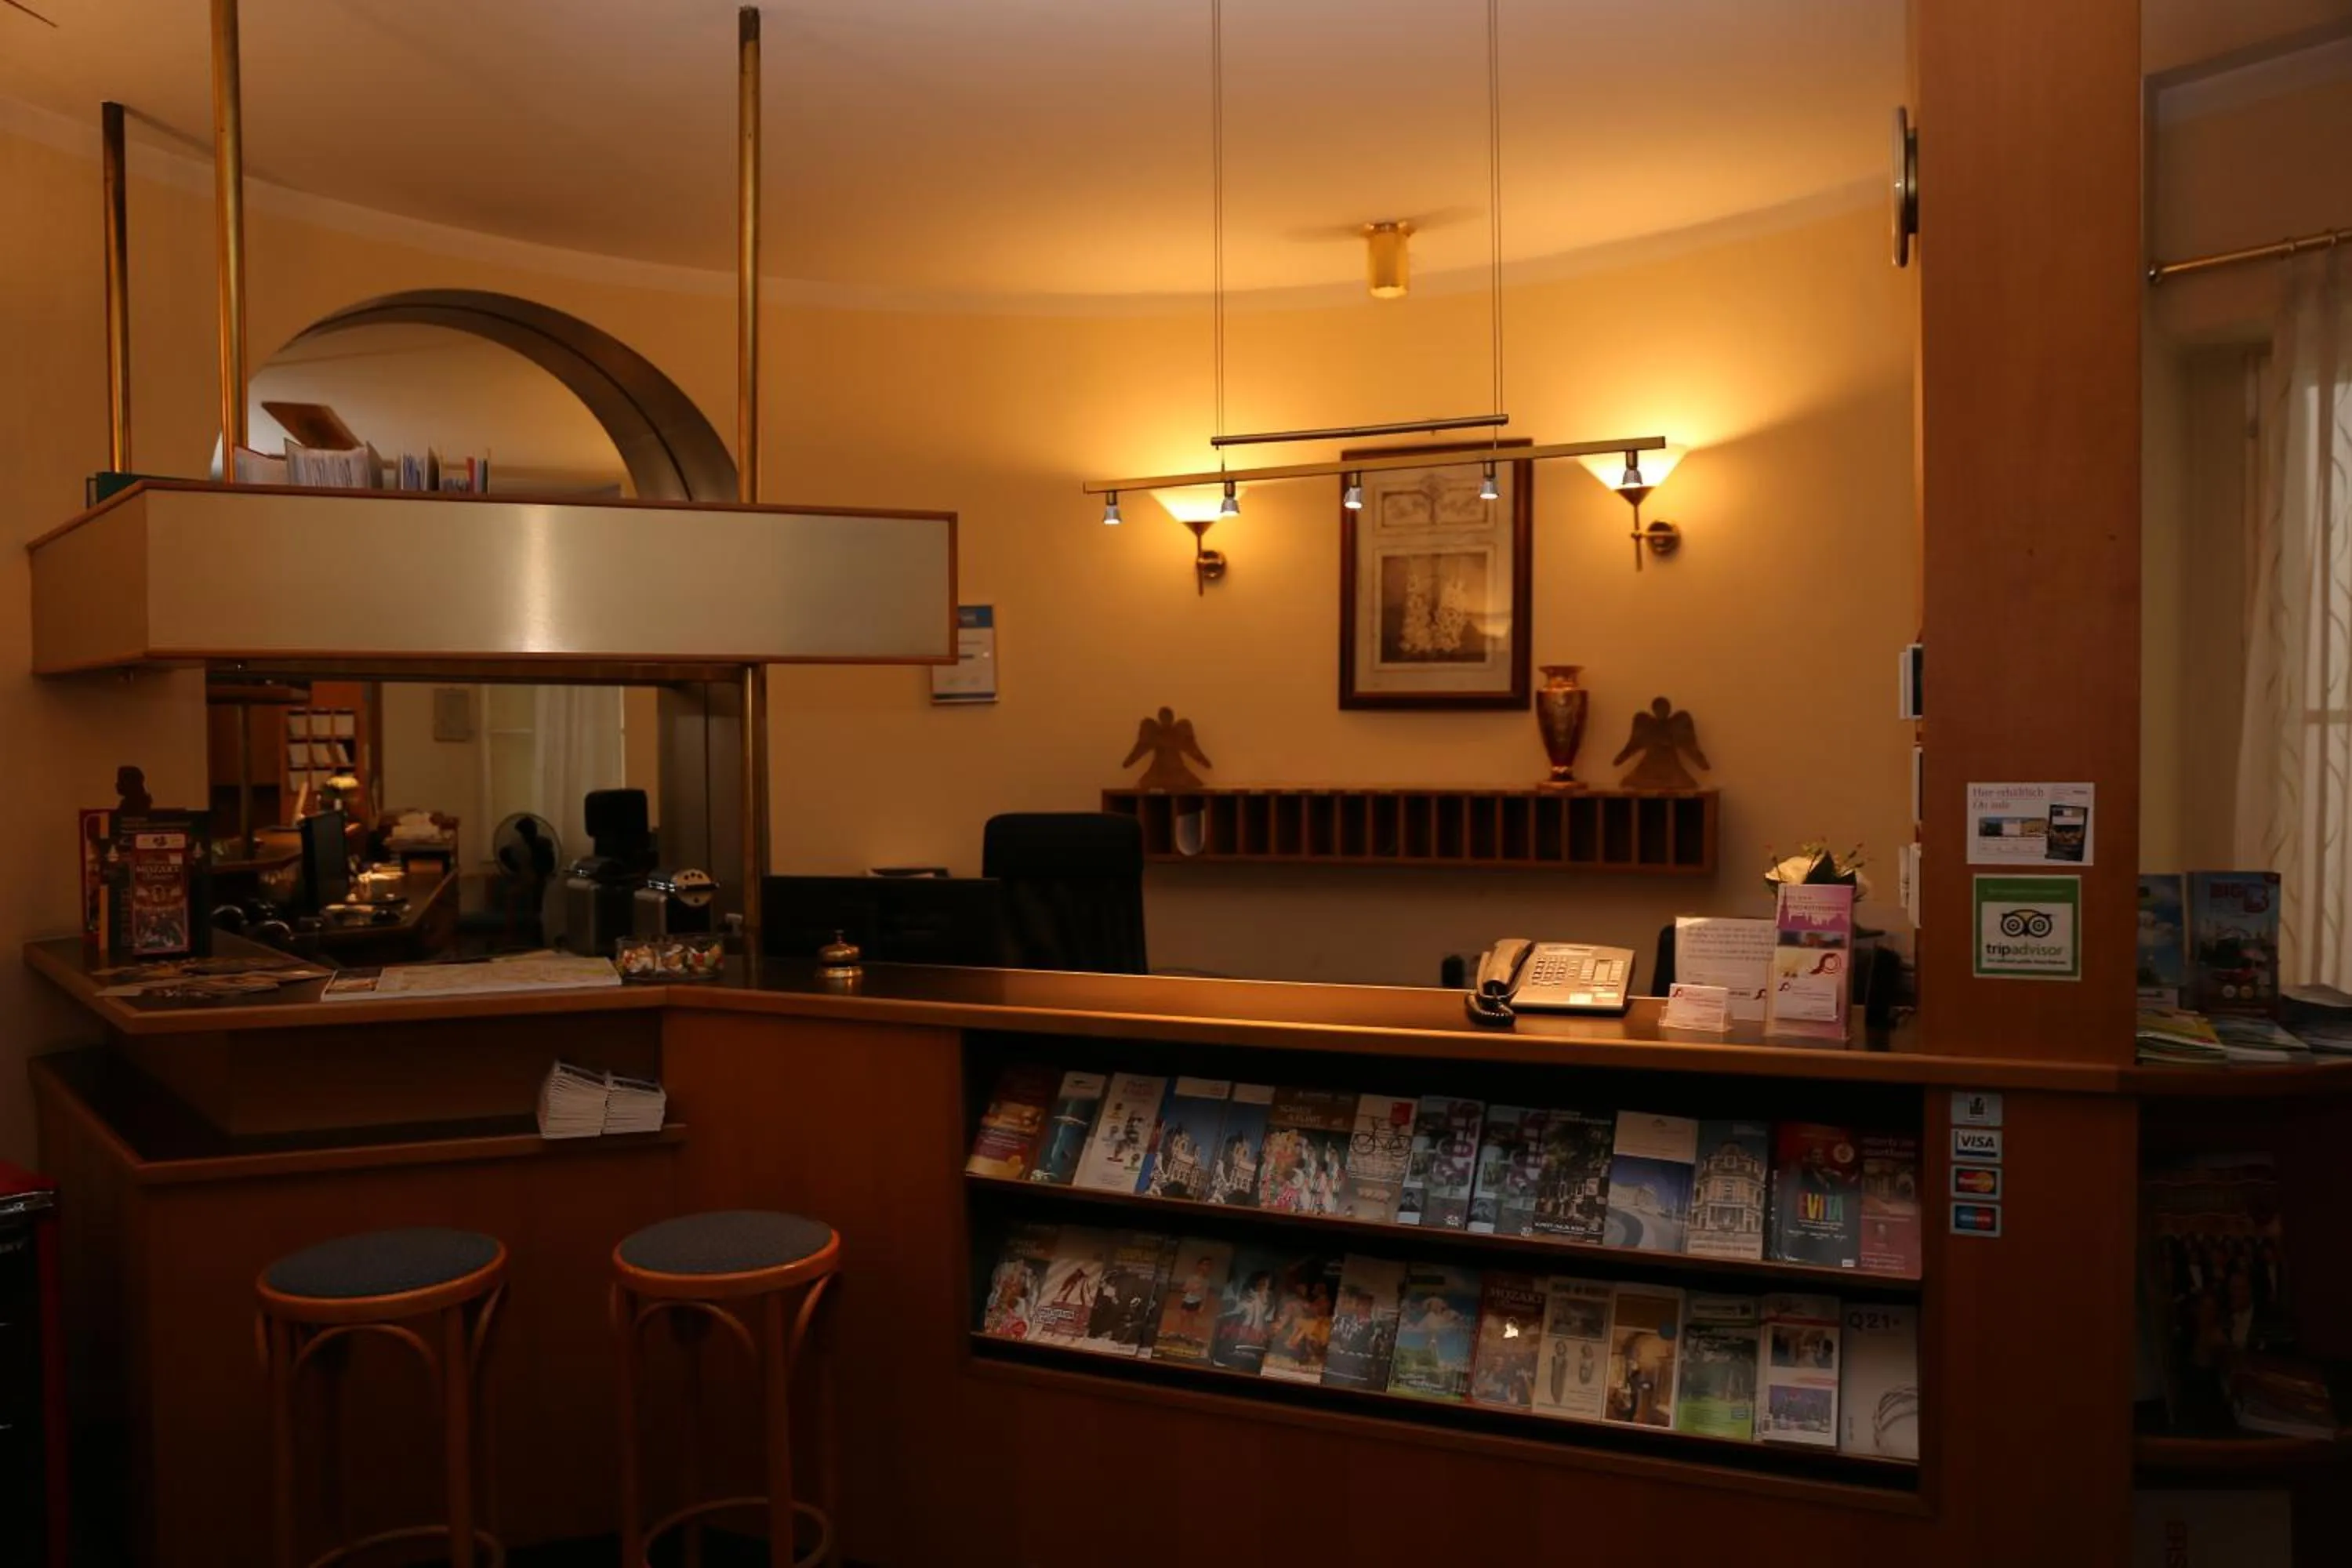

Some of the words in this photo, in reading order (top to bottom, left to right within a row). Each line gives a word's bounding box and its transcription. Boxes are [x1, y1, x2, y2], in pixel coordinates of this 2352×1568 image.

[1986, 942, 2063, 957] tripadvisor
[1960, 1135, 1995, 1149] VISA
[1798, 1192, 1843, 1221] EVITA
